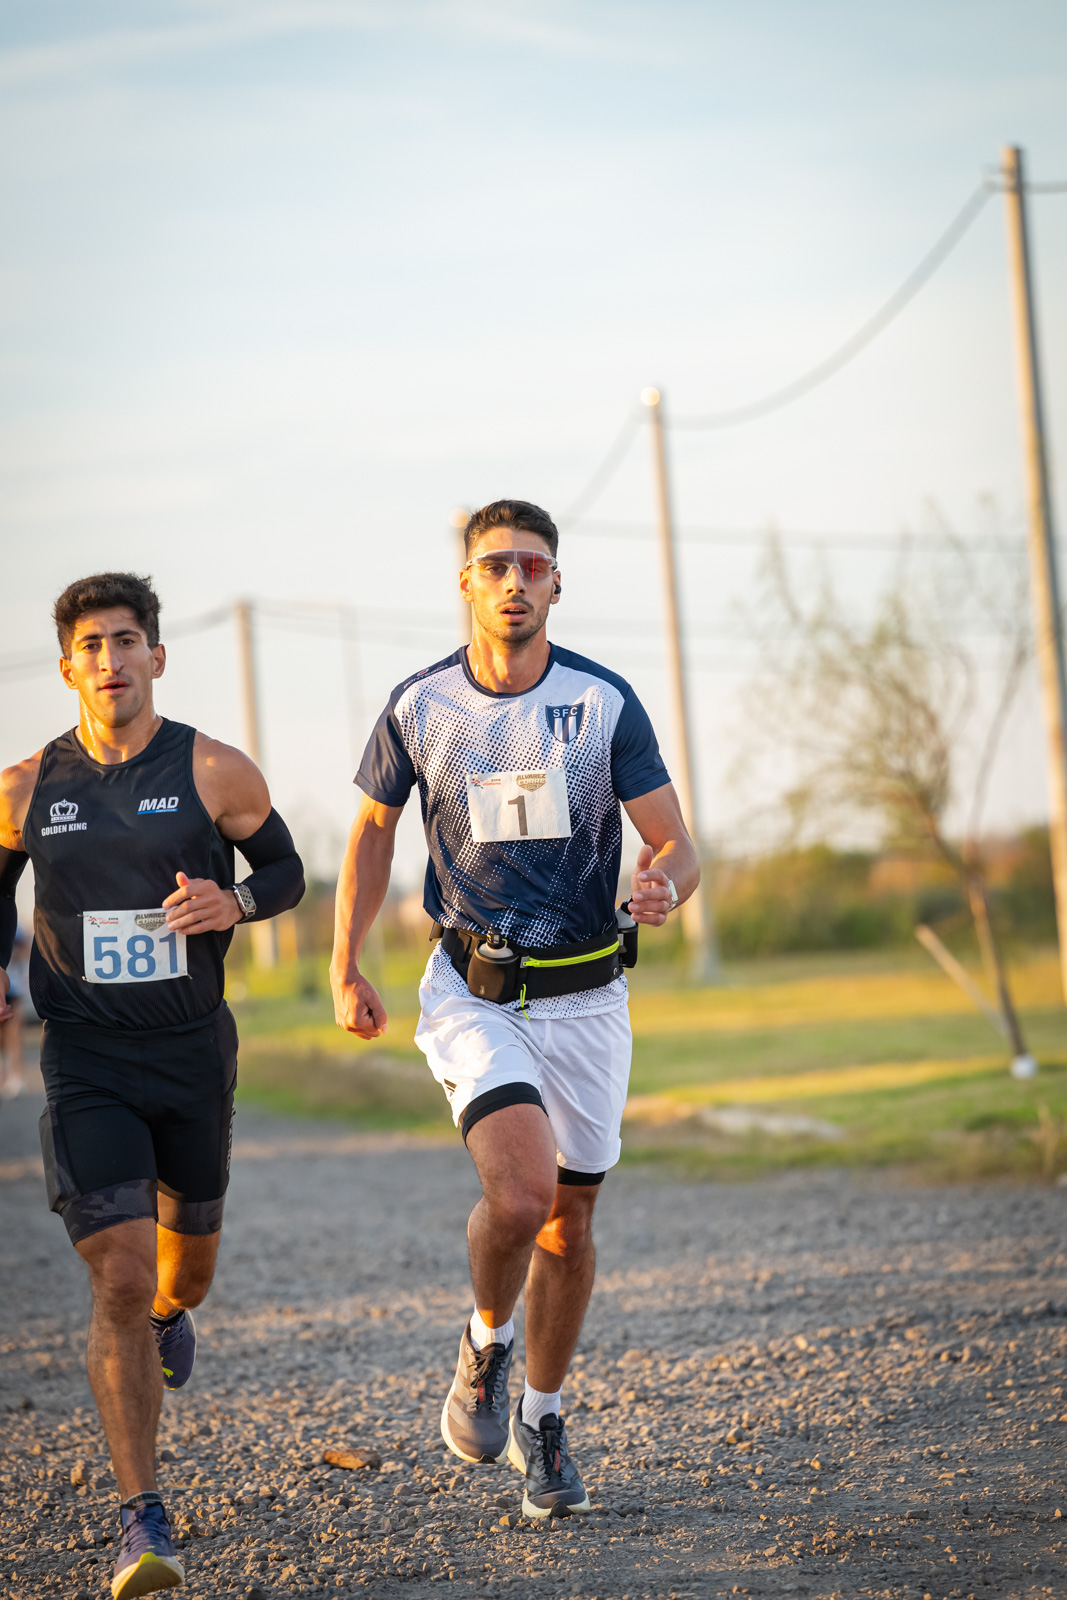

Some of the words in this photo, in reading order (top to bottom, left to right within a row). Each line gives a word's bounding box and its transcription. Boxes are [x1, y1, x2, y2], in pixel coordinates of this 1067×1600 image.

[552, 706, 578, 718] SFC
[138, 796, 179, 812] IMAD
[508, 796, 528, 836] 1
[41, 823, 67, 837] GOLDEN
[68, 822, 87, 832] KING
[94, 932, 178, 979] 581
